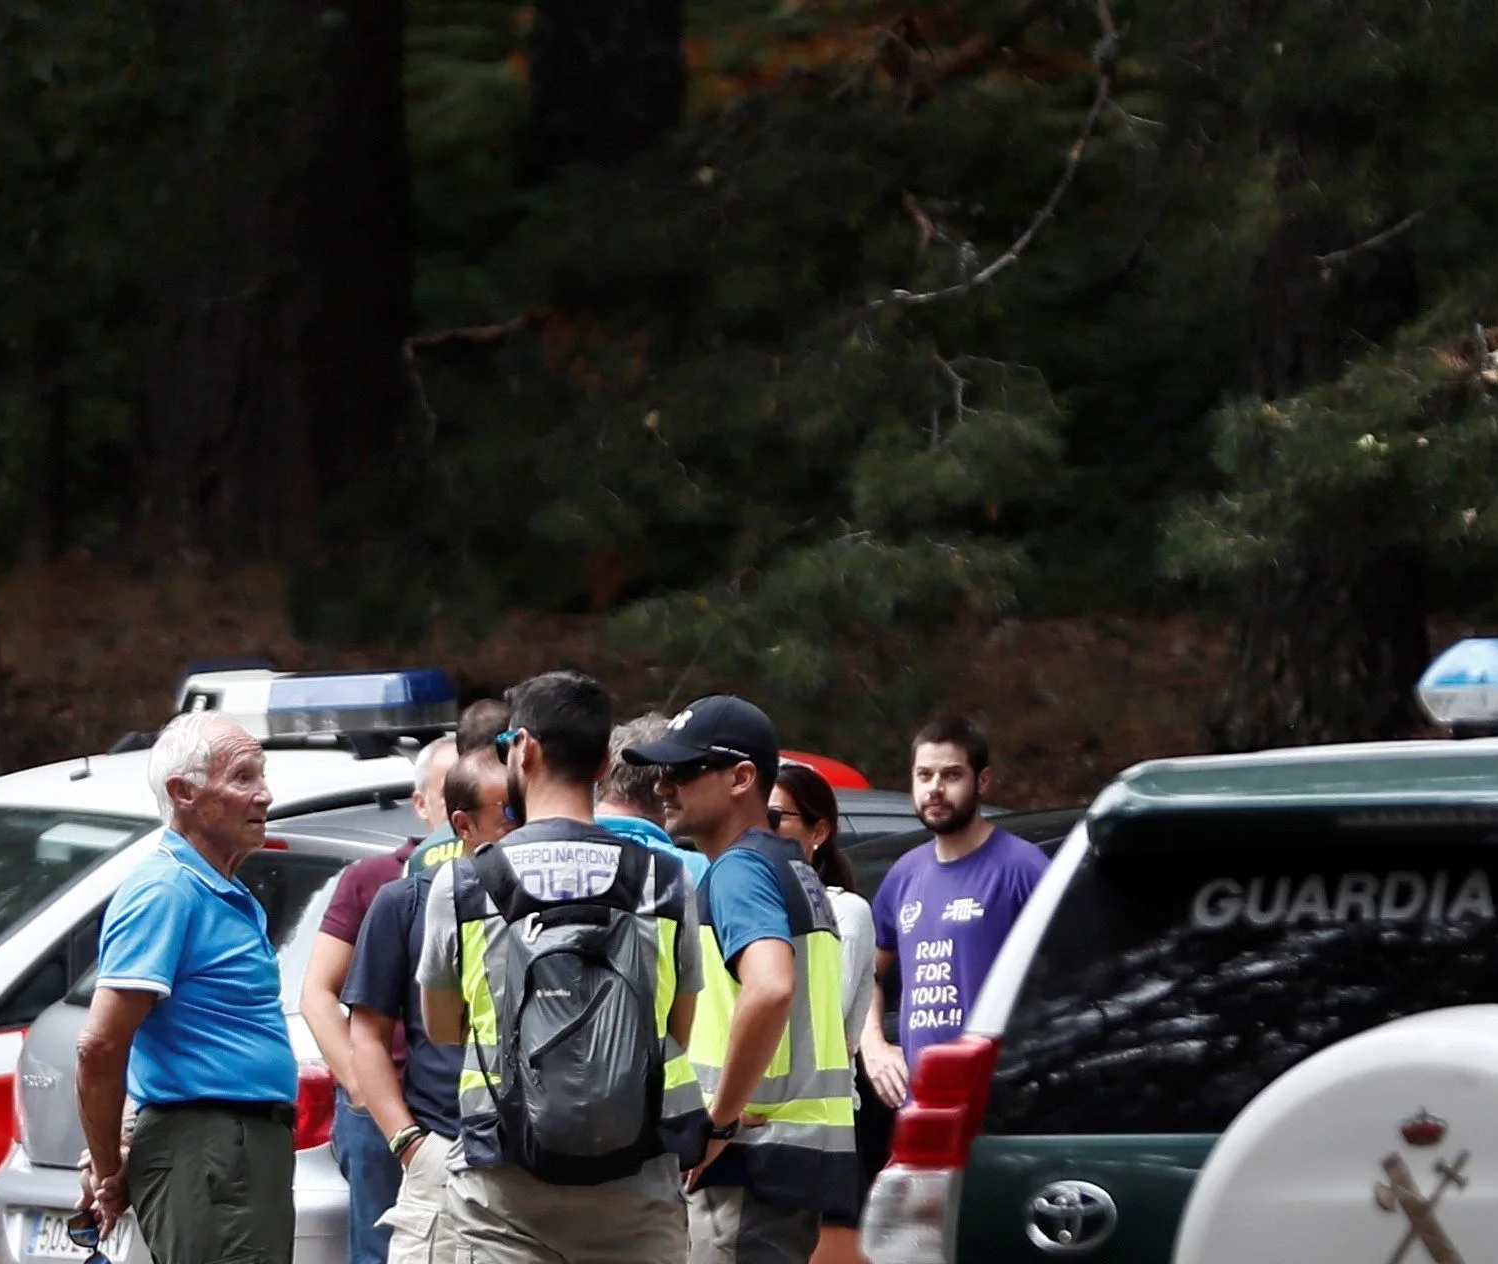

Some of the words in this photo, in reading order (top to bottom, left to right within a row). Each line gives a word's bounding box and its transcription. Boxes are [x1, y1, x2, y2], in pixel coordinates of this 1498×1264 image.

[555, 848, 619, 866] NACIONA
[520, 869, 611, 900] OLIC
[1194, 871, 1495, 928] GUARDIA
[916, 939, 953, 960] RUN
[916, 962, 951, 983] FOR
[912, 984, 958, 1005] YOUR
[909, 1008, 962, 1030] GOAL!!
